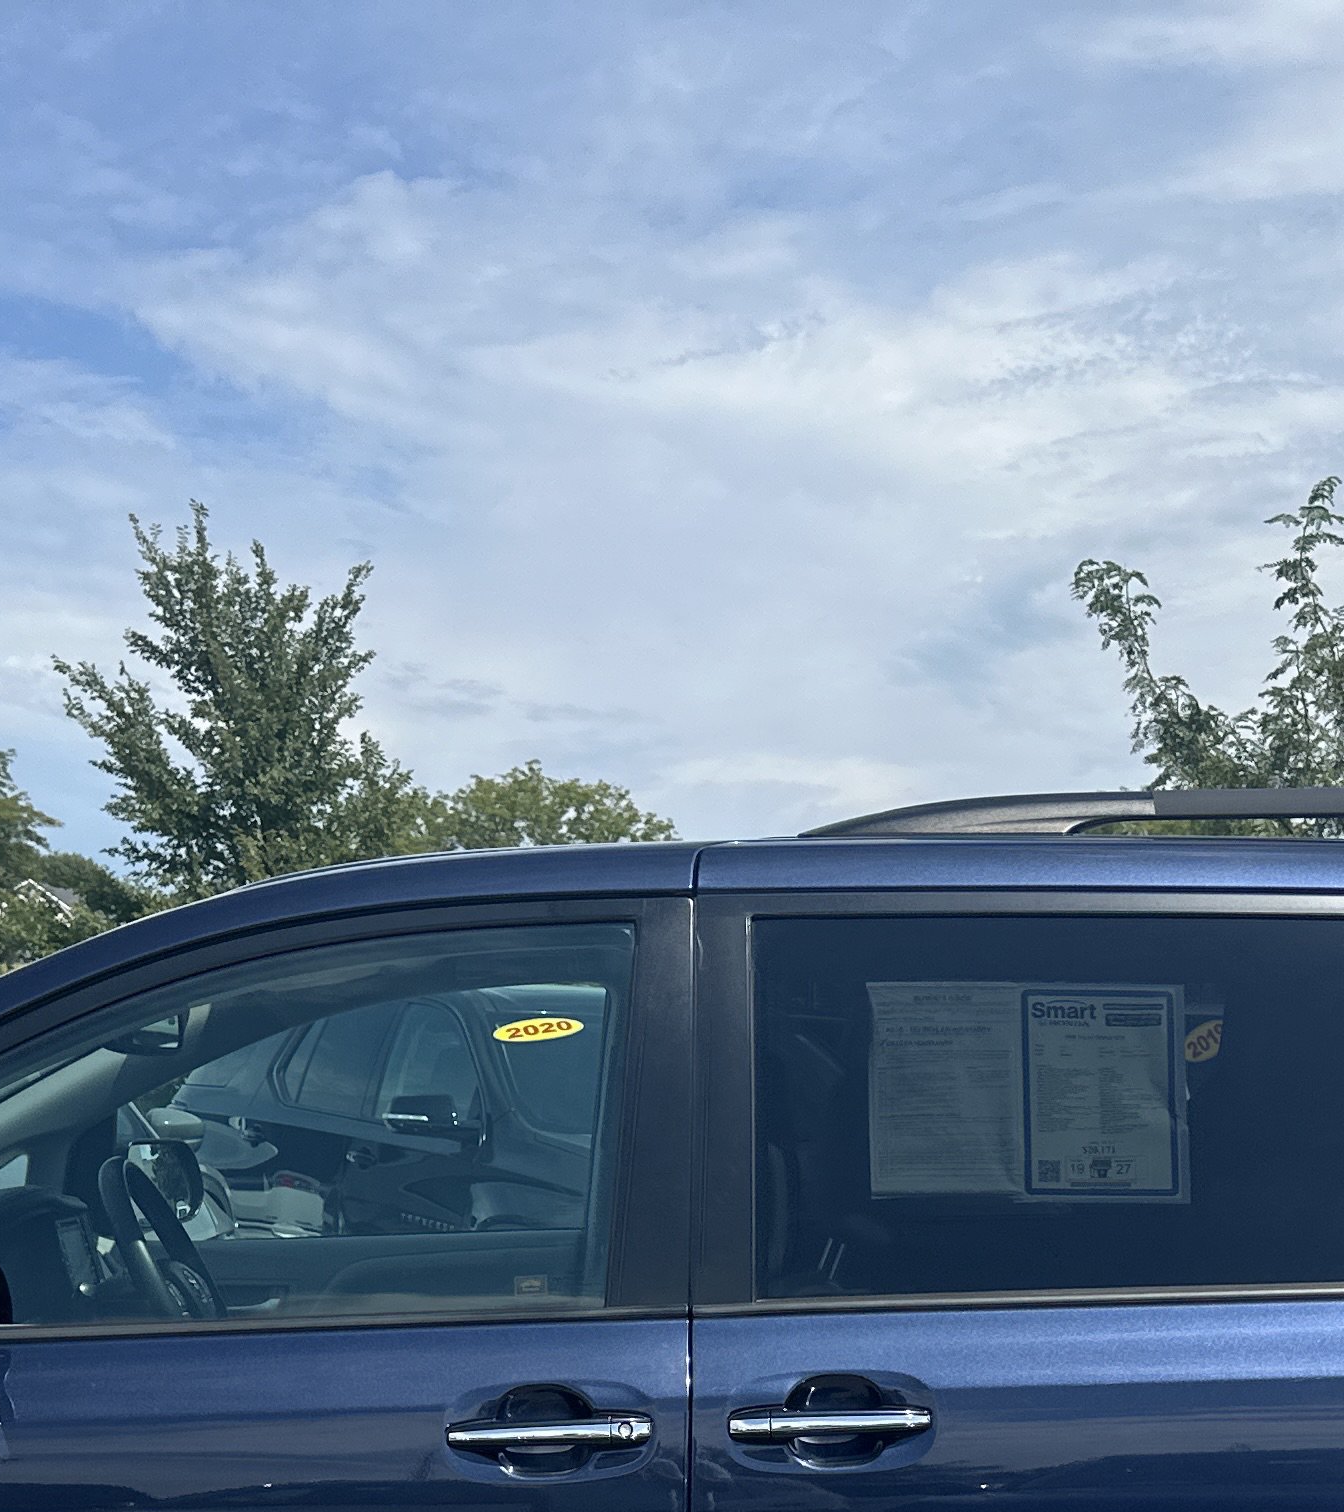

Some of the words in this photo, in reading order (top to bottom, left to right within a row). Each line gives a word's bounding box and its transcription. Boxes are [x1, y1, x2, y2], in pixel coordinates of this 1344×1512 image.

[1031, 1001, 1097, 1020] Smart
[505, 1020, 573, 1040] 2020
[1116, 1163, 1131, 1175] 27
